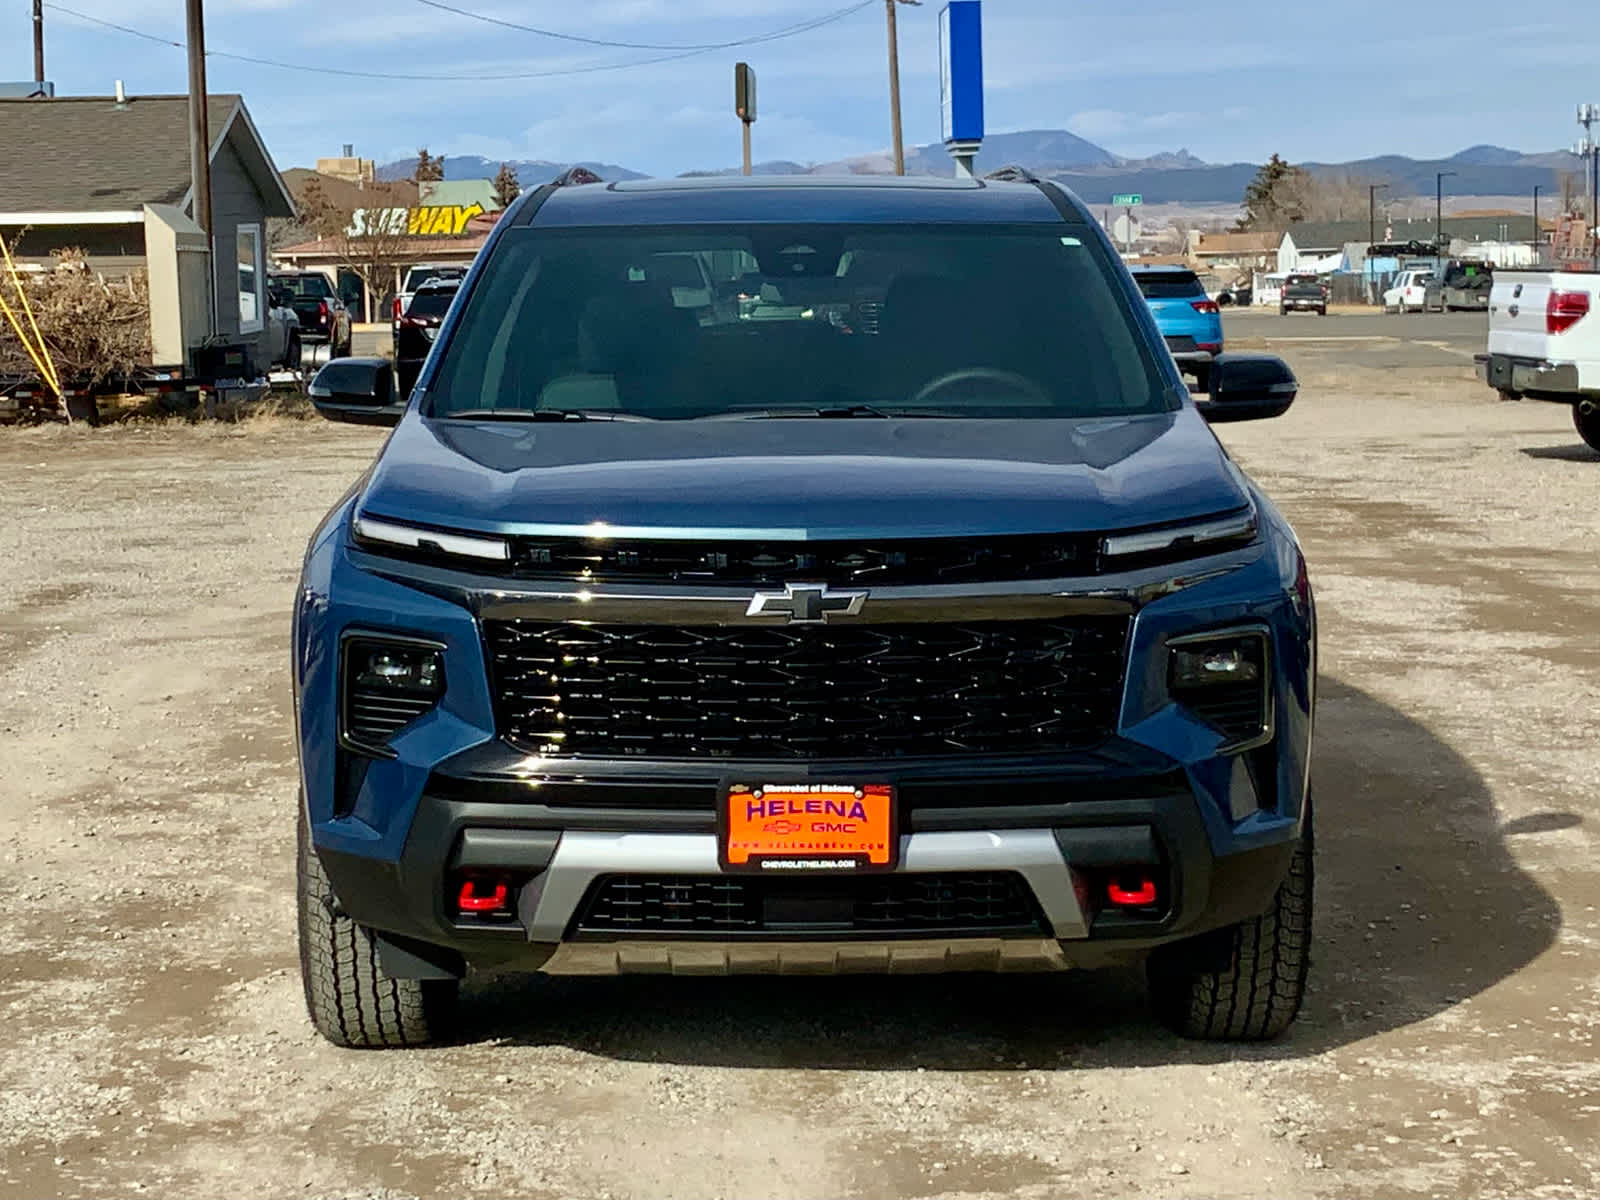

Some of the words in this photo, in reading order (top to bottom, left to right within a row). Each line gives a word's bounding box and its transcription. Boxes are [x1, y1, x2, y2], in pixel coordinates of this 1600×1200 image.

[343, 202, 485, 237] SUBWAY
[864, 785, 892, 793] GMC
[746, 800, 868, 823] HELENA
[811, 823, 857, 833] GMC
